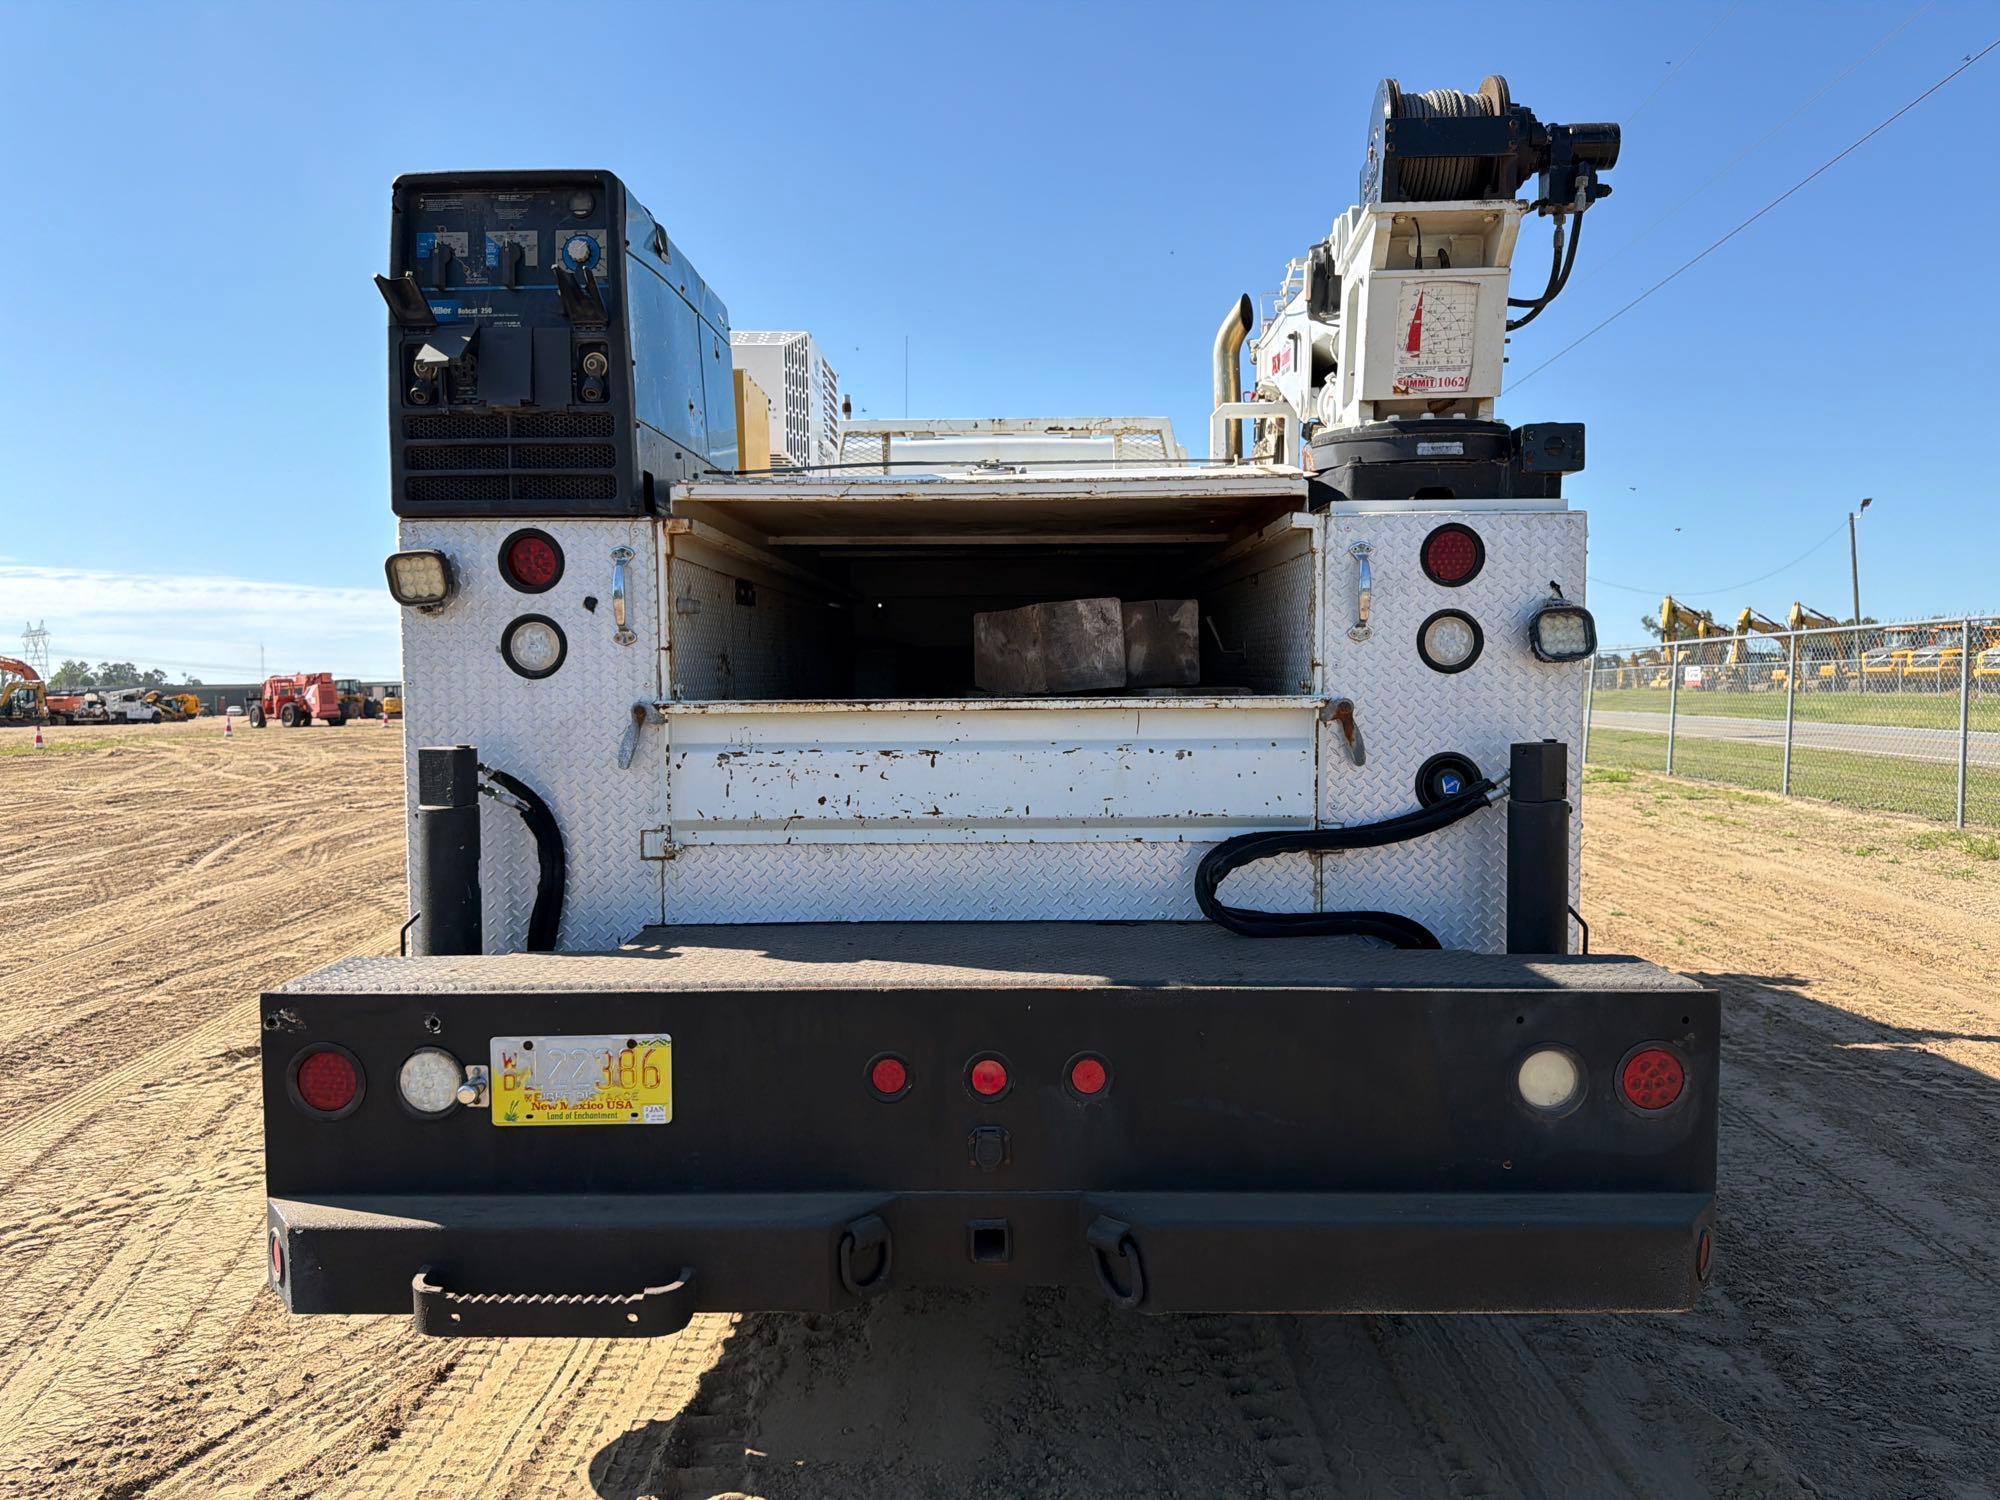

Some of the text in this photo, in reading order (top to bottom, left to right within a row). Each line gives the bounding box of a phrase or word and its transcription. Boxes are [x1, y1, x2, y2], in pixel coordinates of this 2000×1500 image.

[457, 307, 493, 315] Bobcat 250
[1397, 378, 1435, 388] SUMMIT
[531, 1102, 558, 1111] New
[606, 1100, 633, 1110] USA
[546, 1111, 618, 1120] Land of Enchantment
